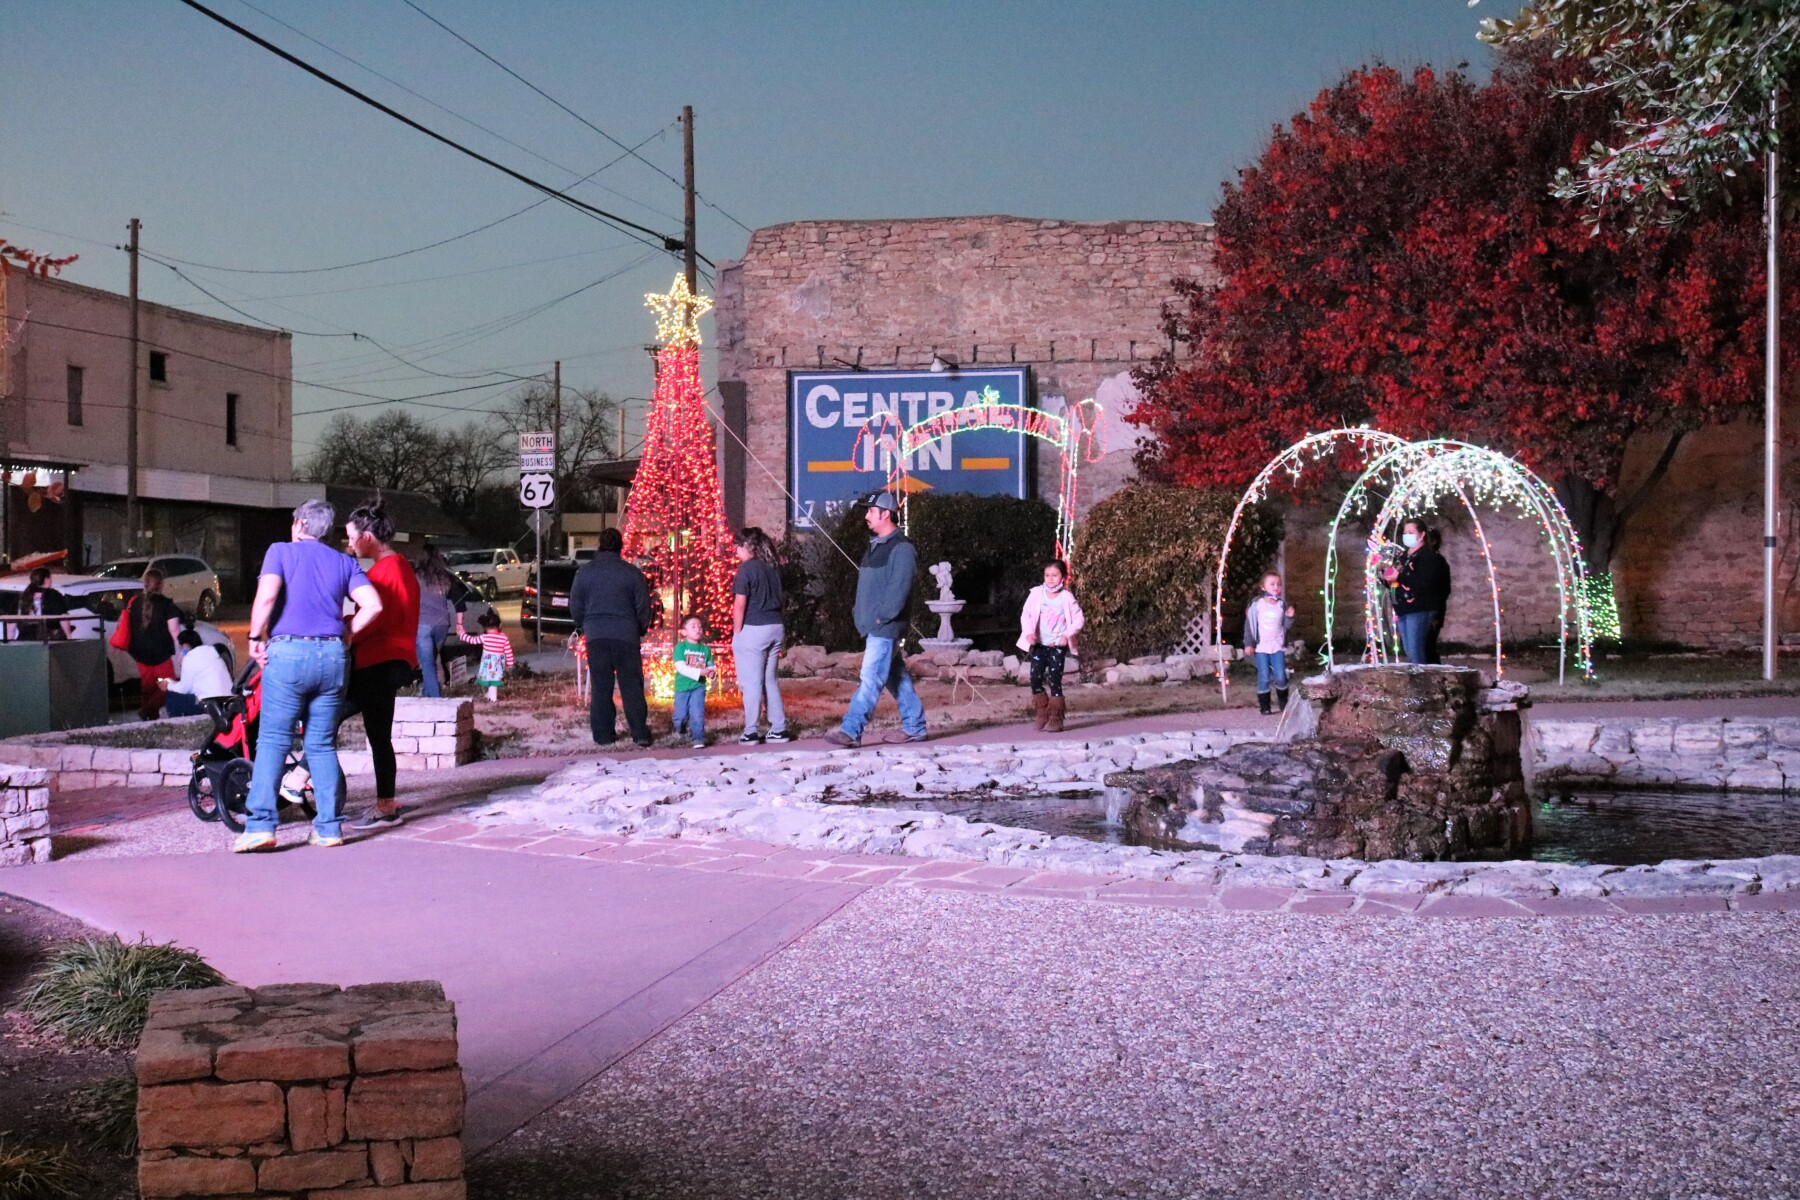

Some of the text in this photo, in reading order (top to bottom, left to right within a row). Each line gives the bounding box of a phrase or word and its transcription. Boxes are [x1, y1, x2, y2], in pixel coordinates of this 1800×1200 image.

[805, 384, 1012, 429] CENTRAL
[521, 436, 553, 448] NORTH
[863, 432, 953, 472] INN
[521, 457, 553, 467] BUSINESS
[524, 481, 551, 501] 67
